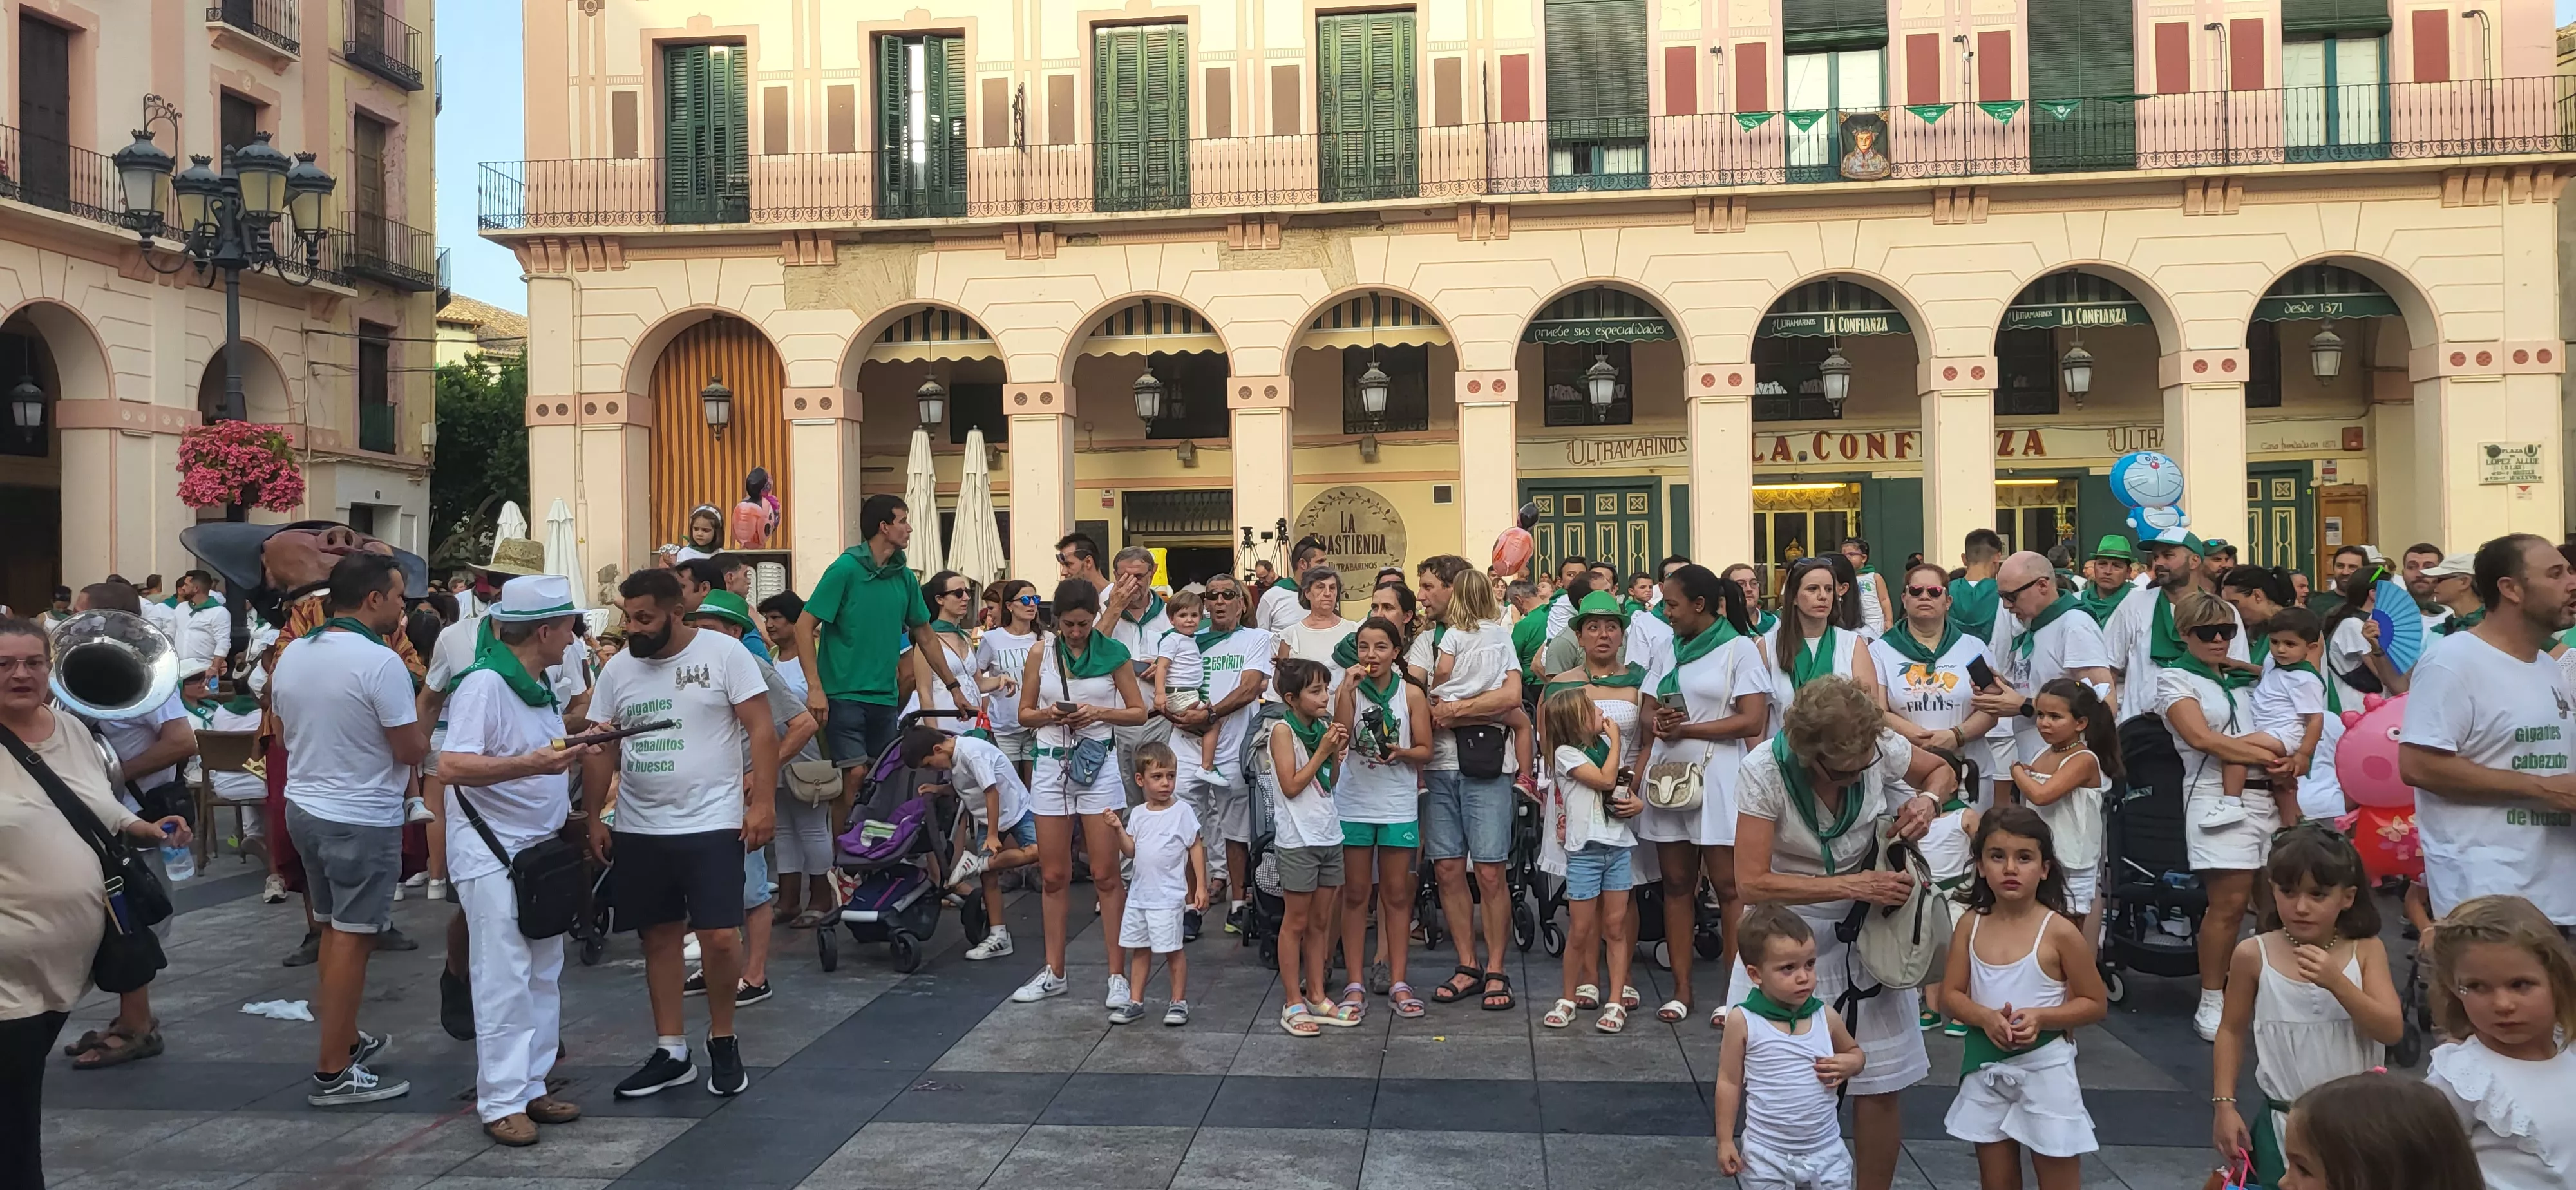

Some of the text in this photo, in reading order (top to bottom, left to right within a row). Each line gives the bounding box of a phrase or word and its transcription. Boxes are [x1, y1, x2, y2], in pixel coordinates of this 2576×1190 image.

[2061, 308, 2074, 325] LA
[2076, 307, 2128, 325] CONFIANZA
[2284, 301, 2343, 314] desde 1871
[1534, 323, 1665, 341] pruebe sus especialidades
[1824, 316, 1835, 334] LA
[1838, 316, 1888, 333] CONFIANZA
[1570, 436, 1689, 464] ULTRAMARINOS
[1340, 510, 1356, 534] LA
[1906, 699, 1954, 712] FRUITS
[634, 759, 675, 773] huesca
[2506, 808, 2526, 826] de
